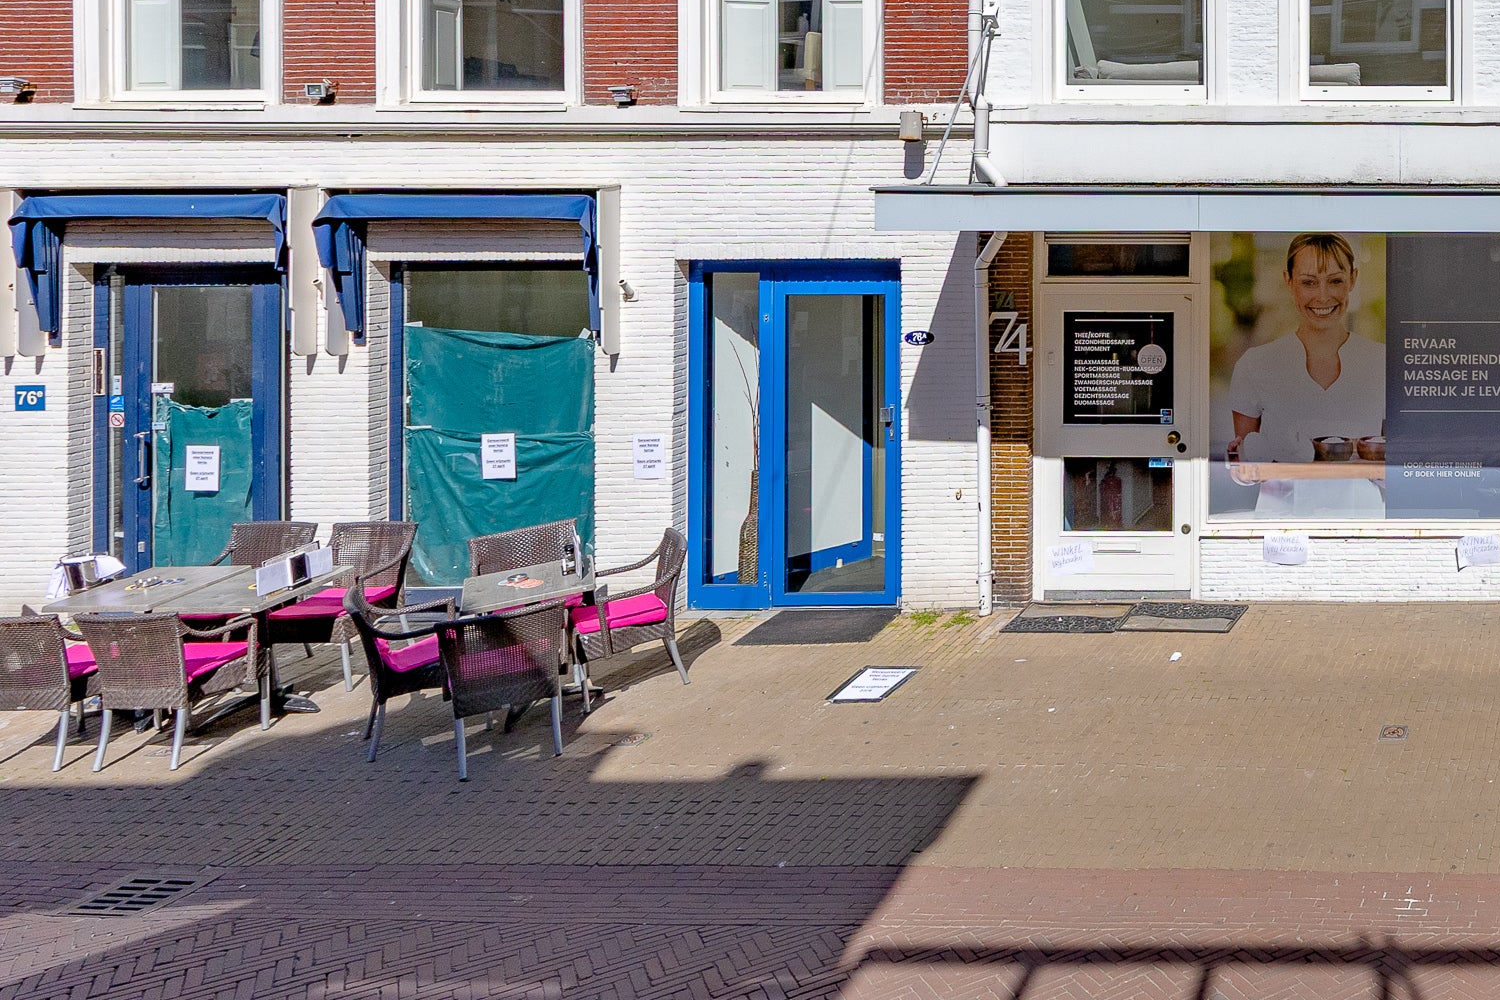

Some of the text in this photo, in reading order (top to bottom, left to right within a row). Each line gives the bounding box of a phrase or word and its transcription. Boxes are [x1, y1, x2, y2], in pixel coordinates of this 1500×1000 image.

[989, 311, 1033, 365] 74
[1404, 338, 1456, 349] ERVAAR
[1404, 370, 1488, 381] MASSAGE EN
[1404, 386, 1457, 397] VERRIJK
[1461, 386, 1475, 397] JE
